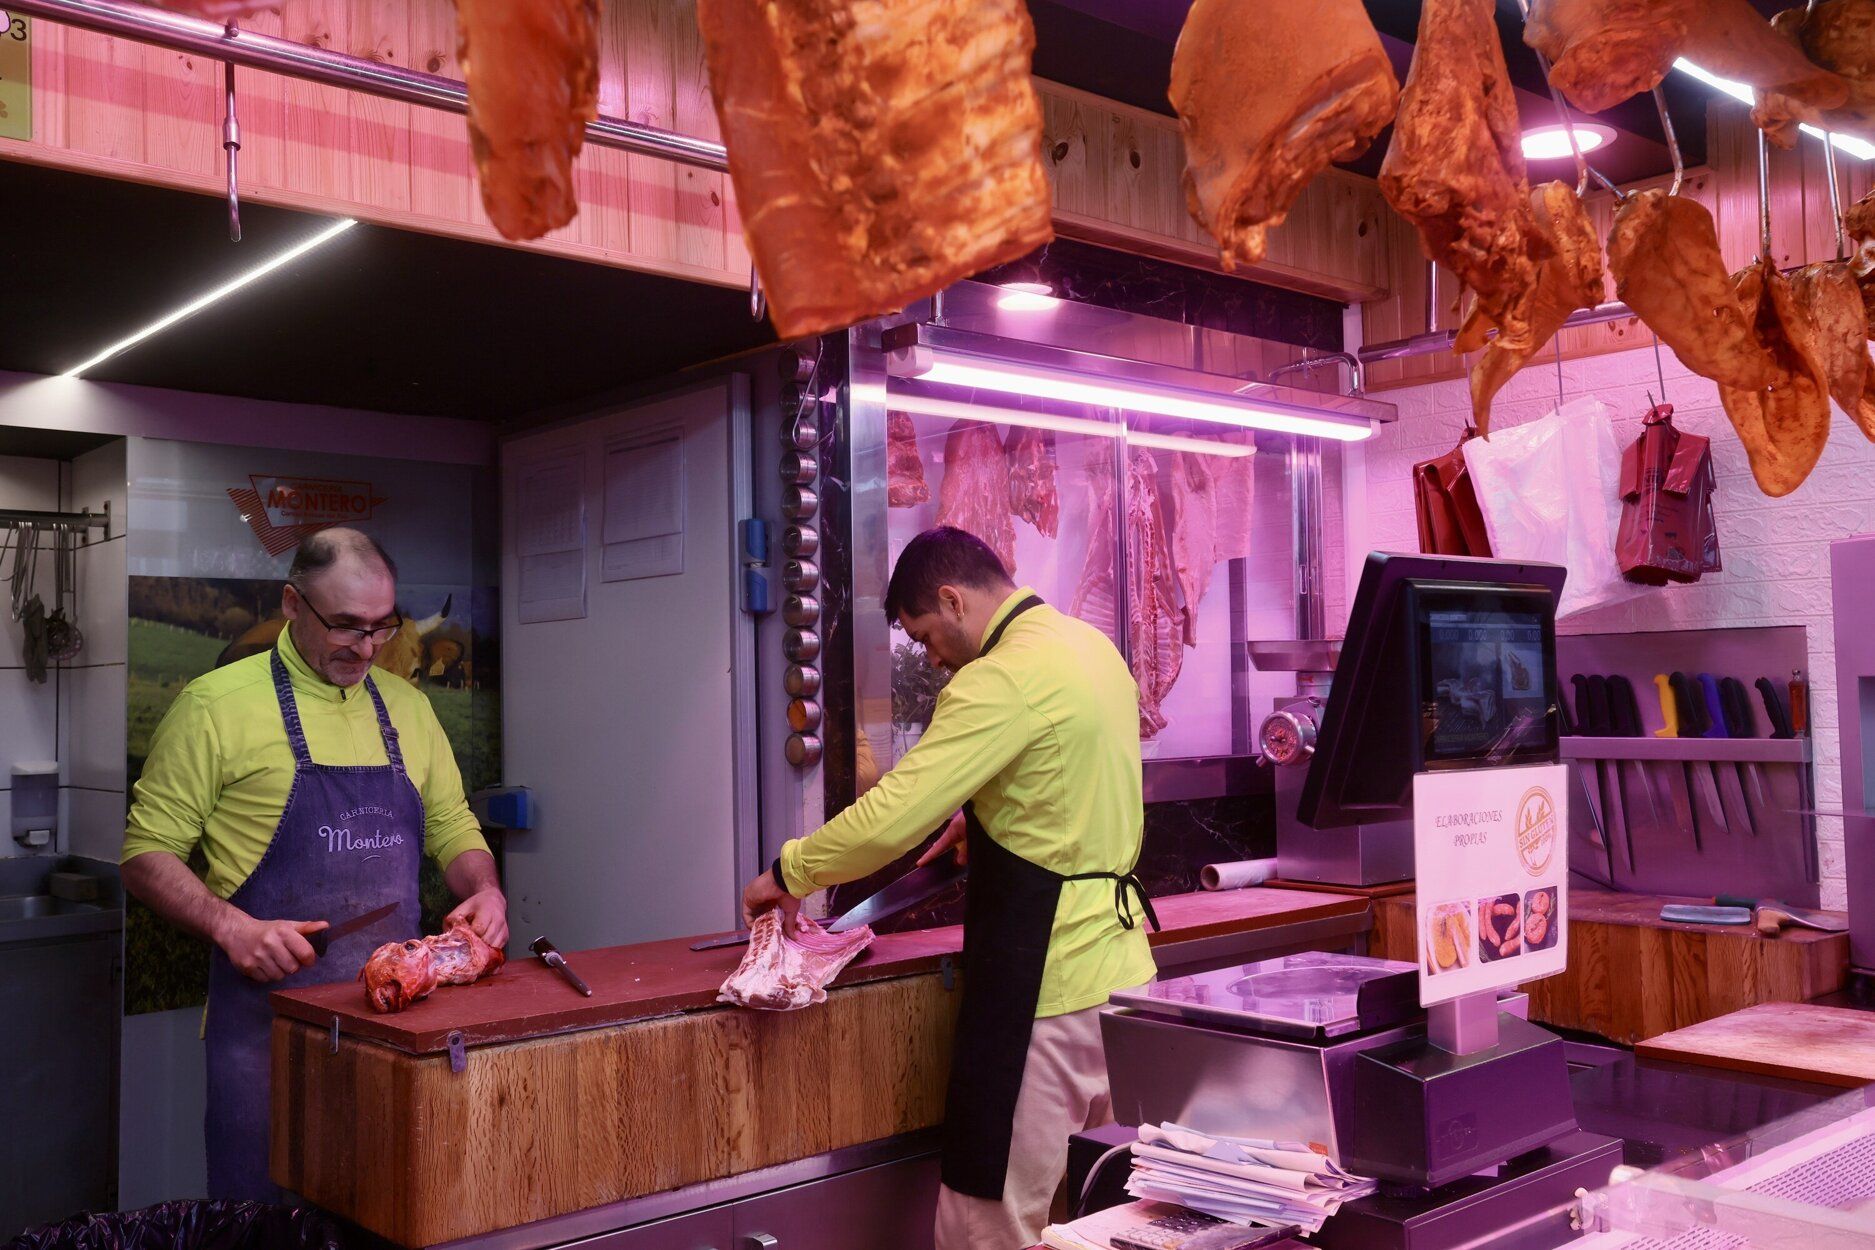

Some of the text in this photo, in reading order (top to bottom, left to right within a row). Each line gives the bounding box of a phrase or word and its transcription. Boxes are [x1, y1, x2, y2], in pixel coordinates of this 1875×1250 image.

[11, 18, 27, 41] 3
[268, 489, 367, 514] MONTERO
[1435, 810, 1502, 829] ELABORACIONES
[1519, 814, 1554, 849] SIN GLUTEN
[318, 825, 404, 853] Montero
[1453, 832, 1488, 848] PROPIAS
